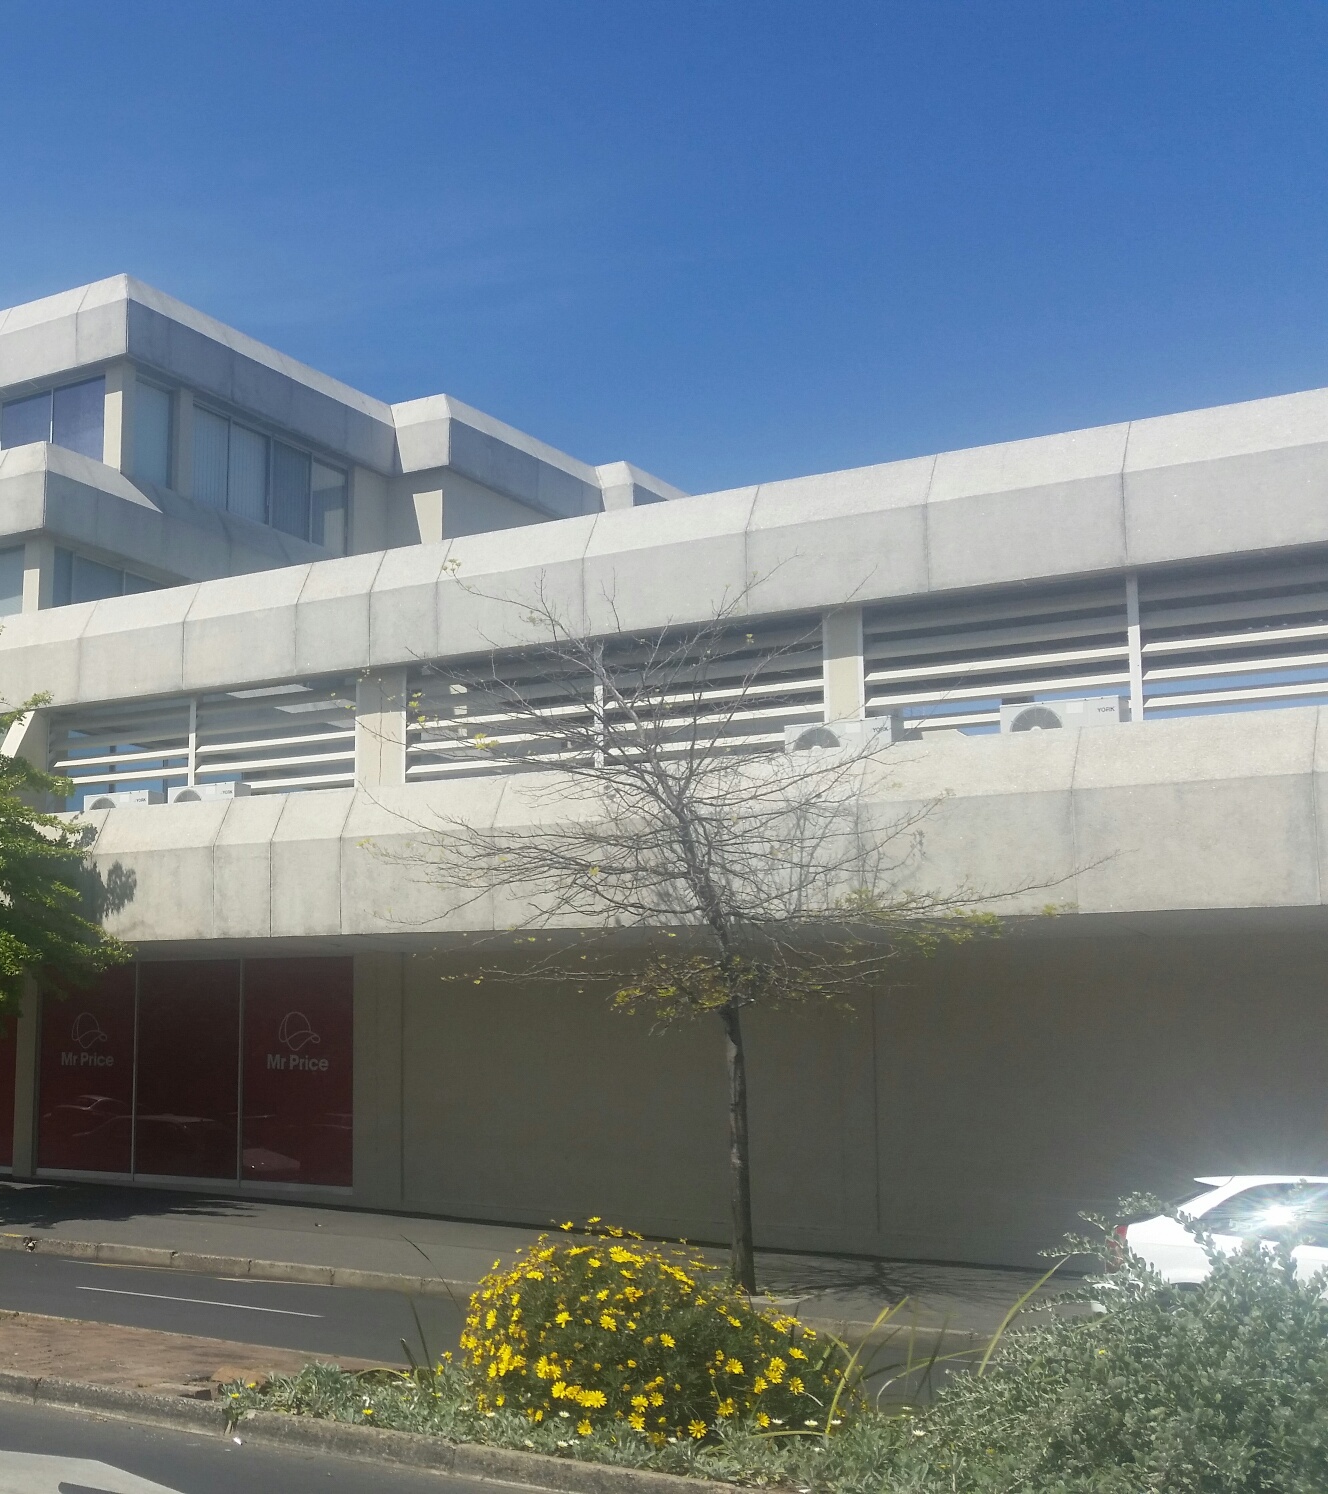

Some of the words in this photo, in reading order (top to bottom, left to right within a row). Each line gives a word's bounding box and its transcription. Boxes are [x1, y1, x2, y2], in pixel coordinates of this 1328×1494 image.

[61, 1051, 78, 1066] Mr
[80, 1051, 114, 1067] Price
[266, 1053, 286, 1070] Mr
[289, 1054, 329, 1071] Price
